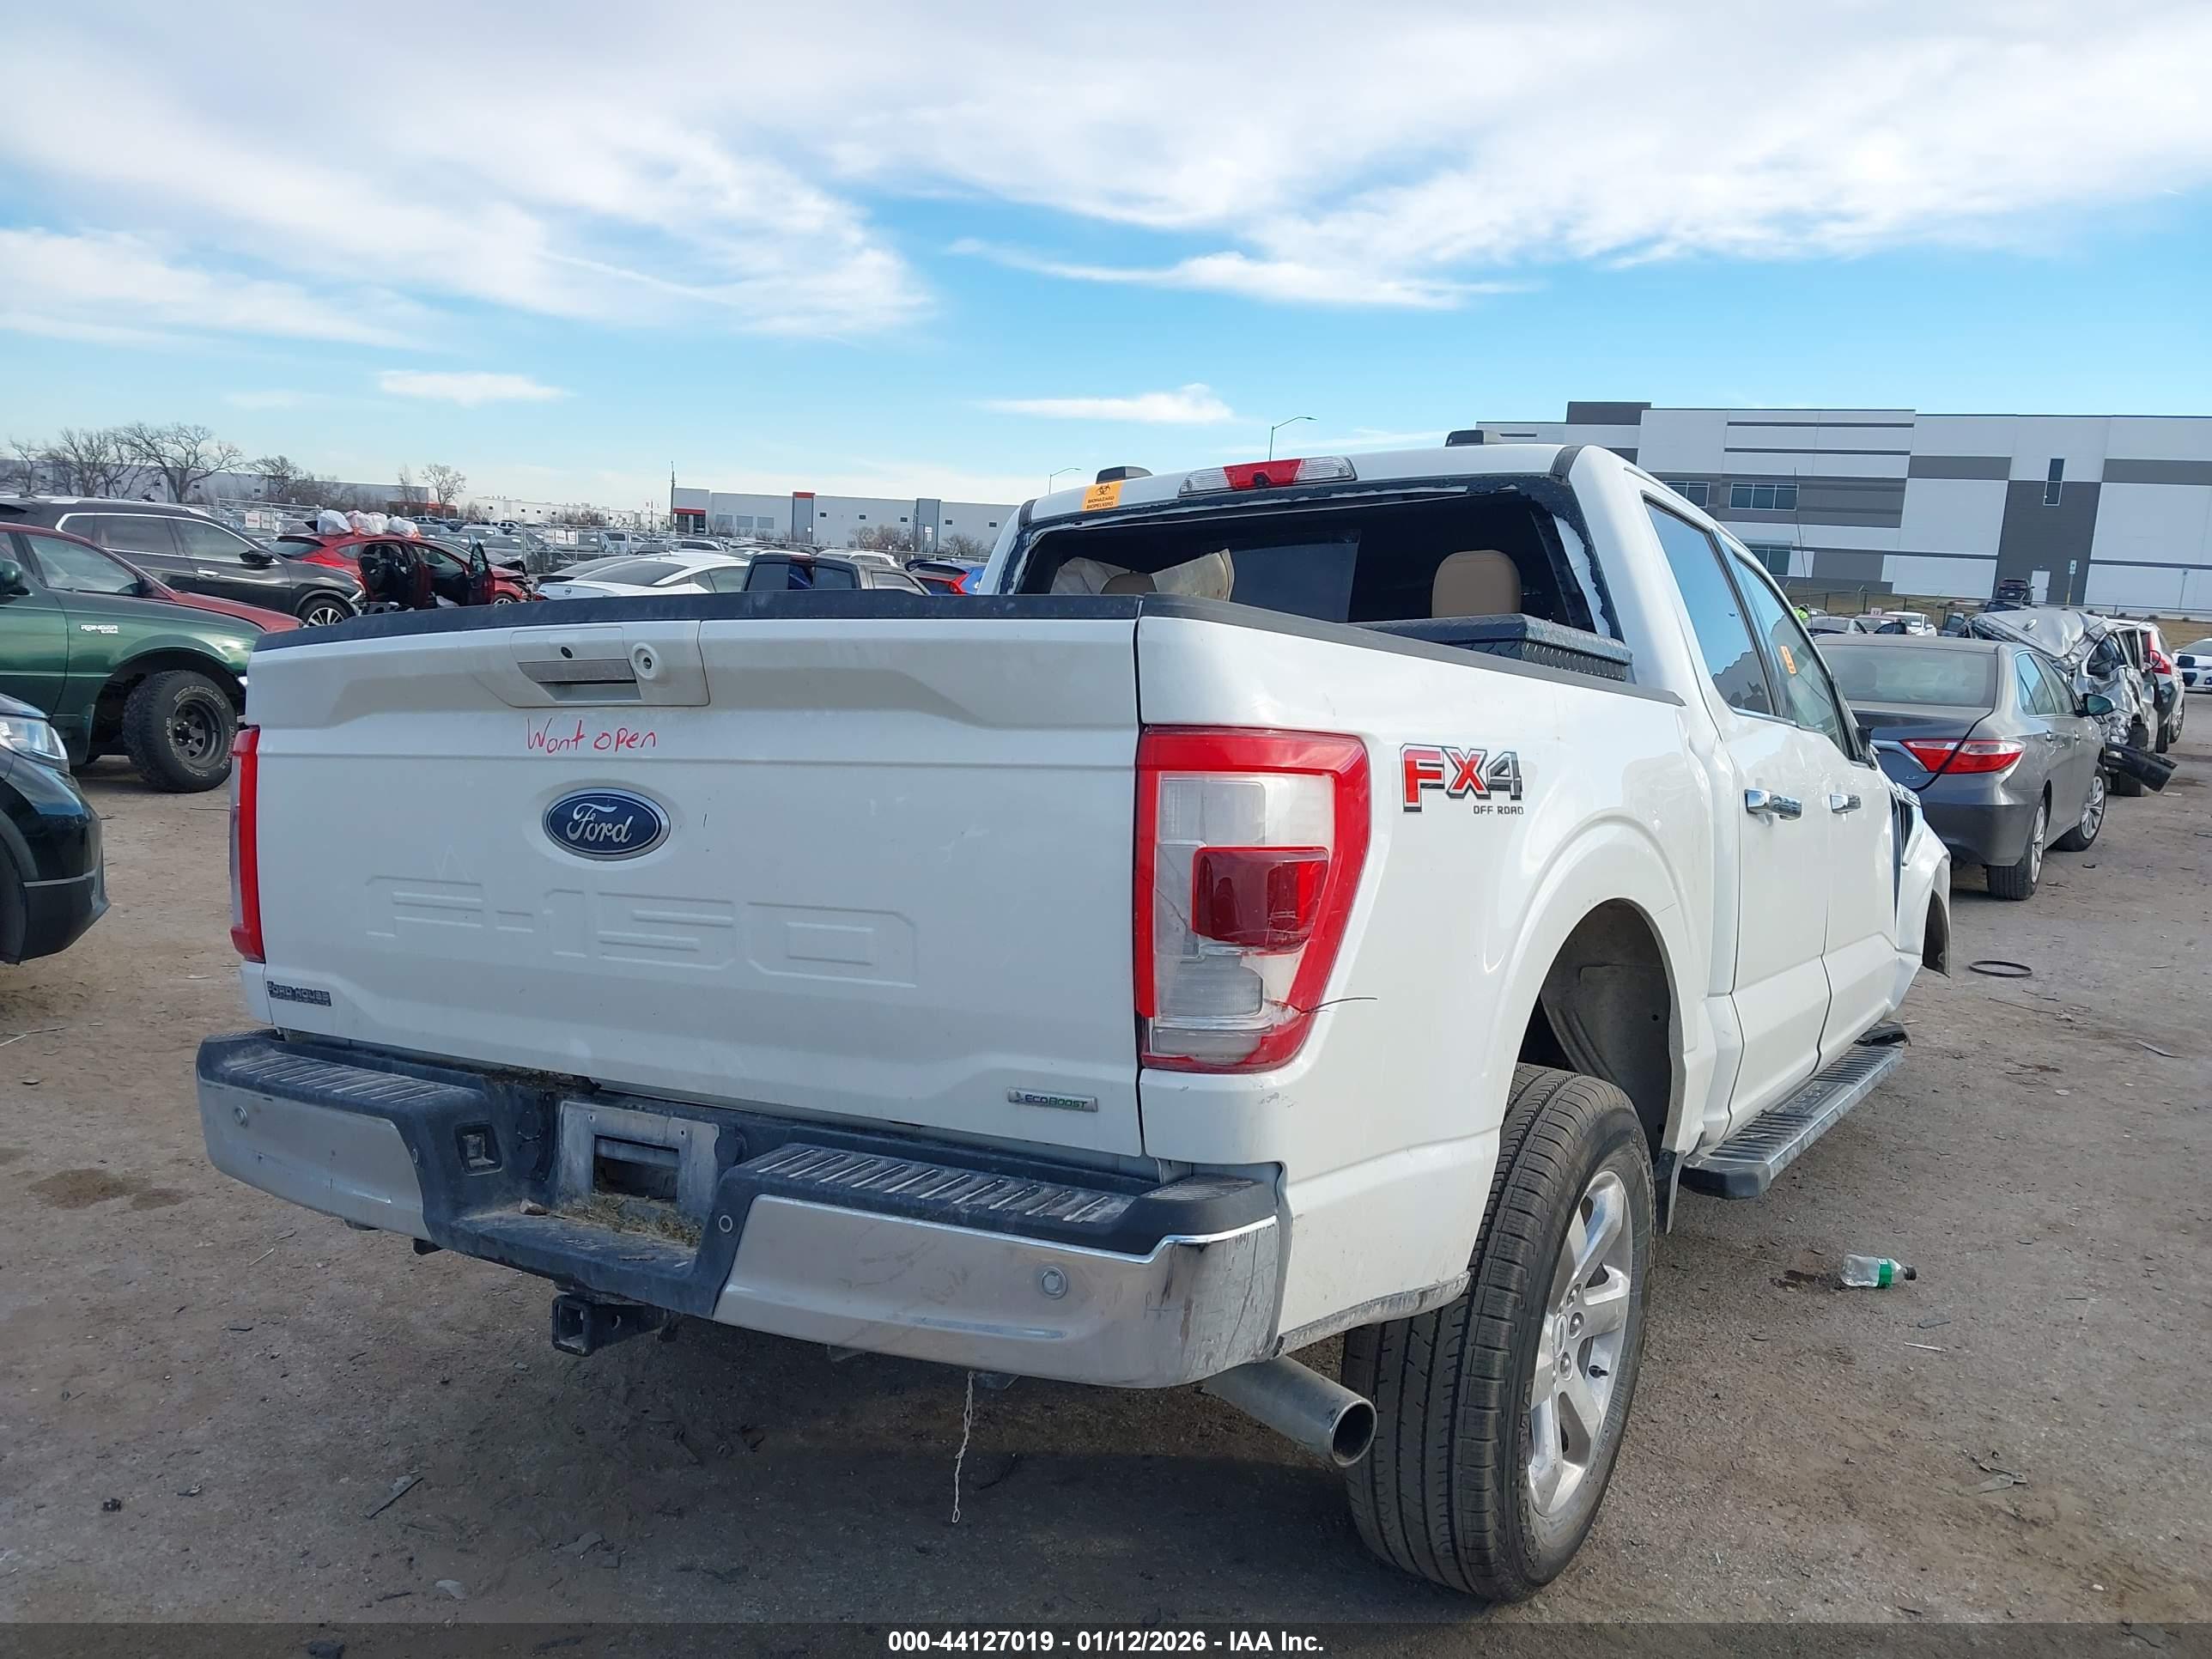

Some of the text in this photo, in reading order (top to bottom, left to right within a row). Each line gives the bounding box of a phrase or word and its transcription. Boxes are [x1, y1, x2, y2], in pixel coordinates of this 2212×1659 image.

[527, 717, 586, 753] Wont
[1400, 743, 1522, 812] FX4
[566, 803, 634, 843] Ford
[1473, 805, 1524, 815] OFF ROAD
